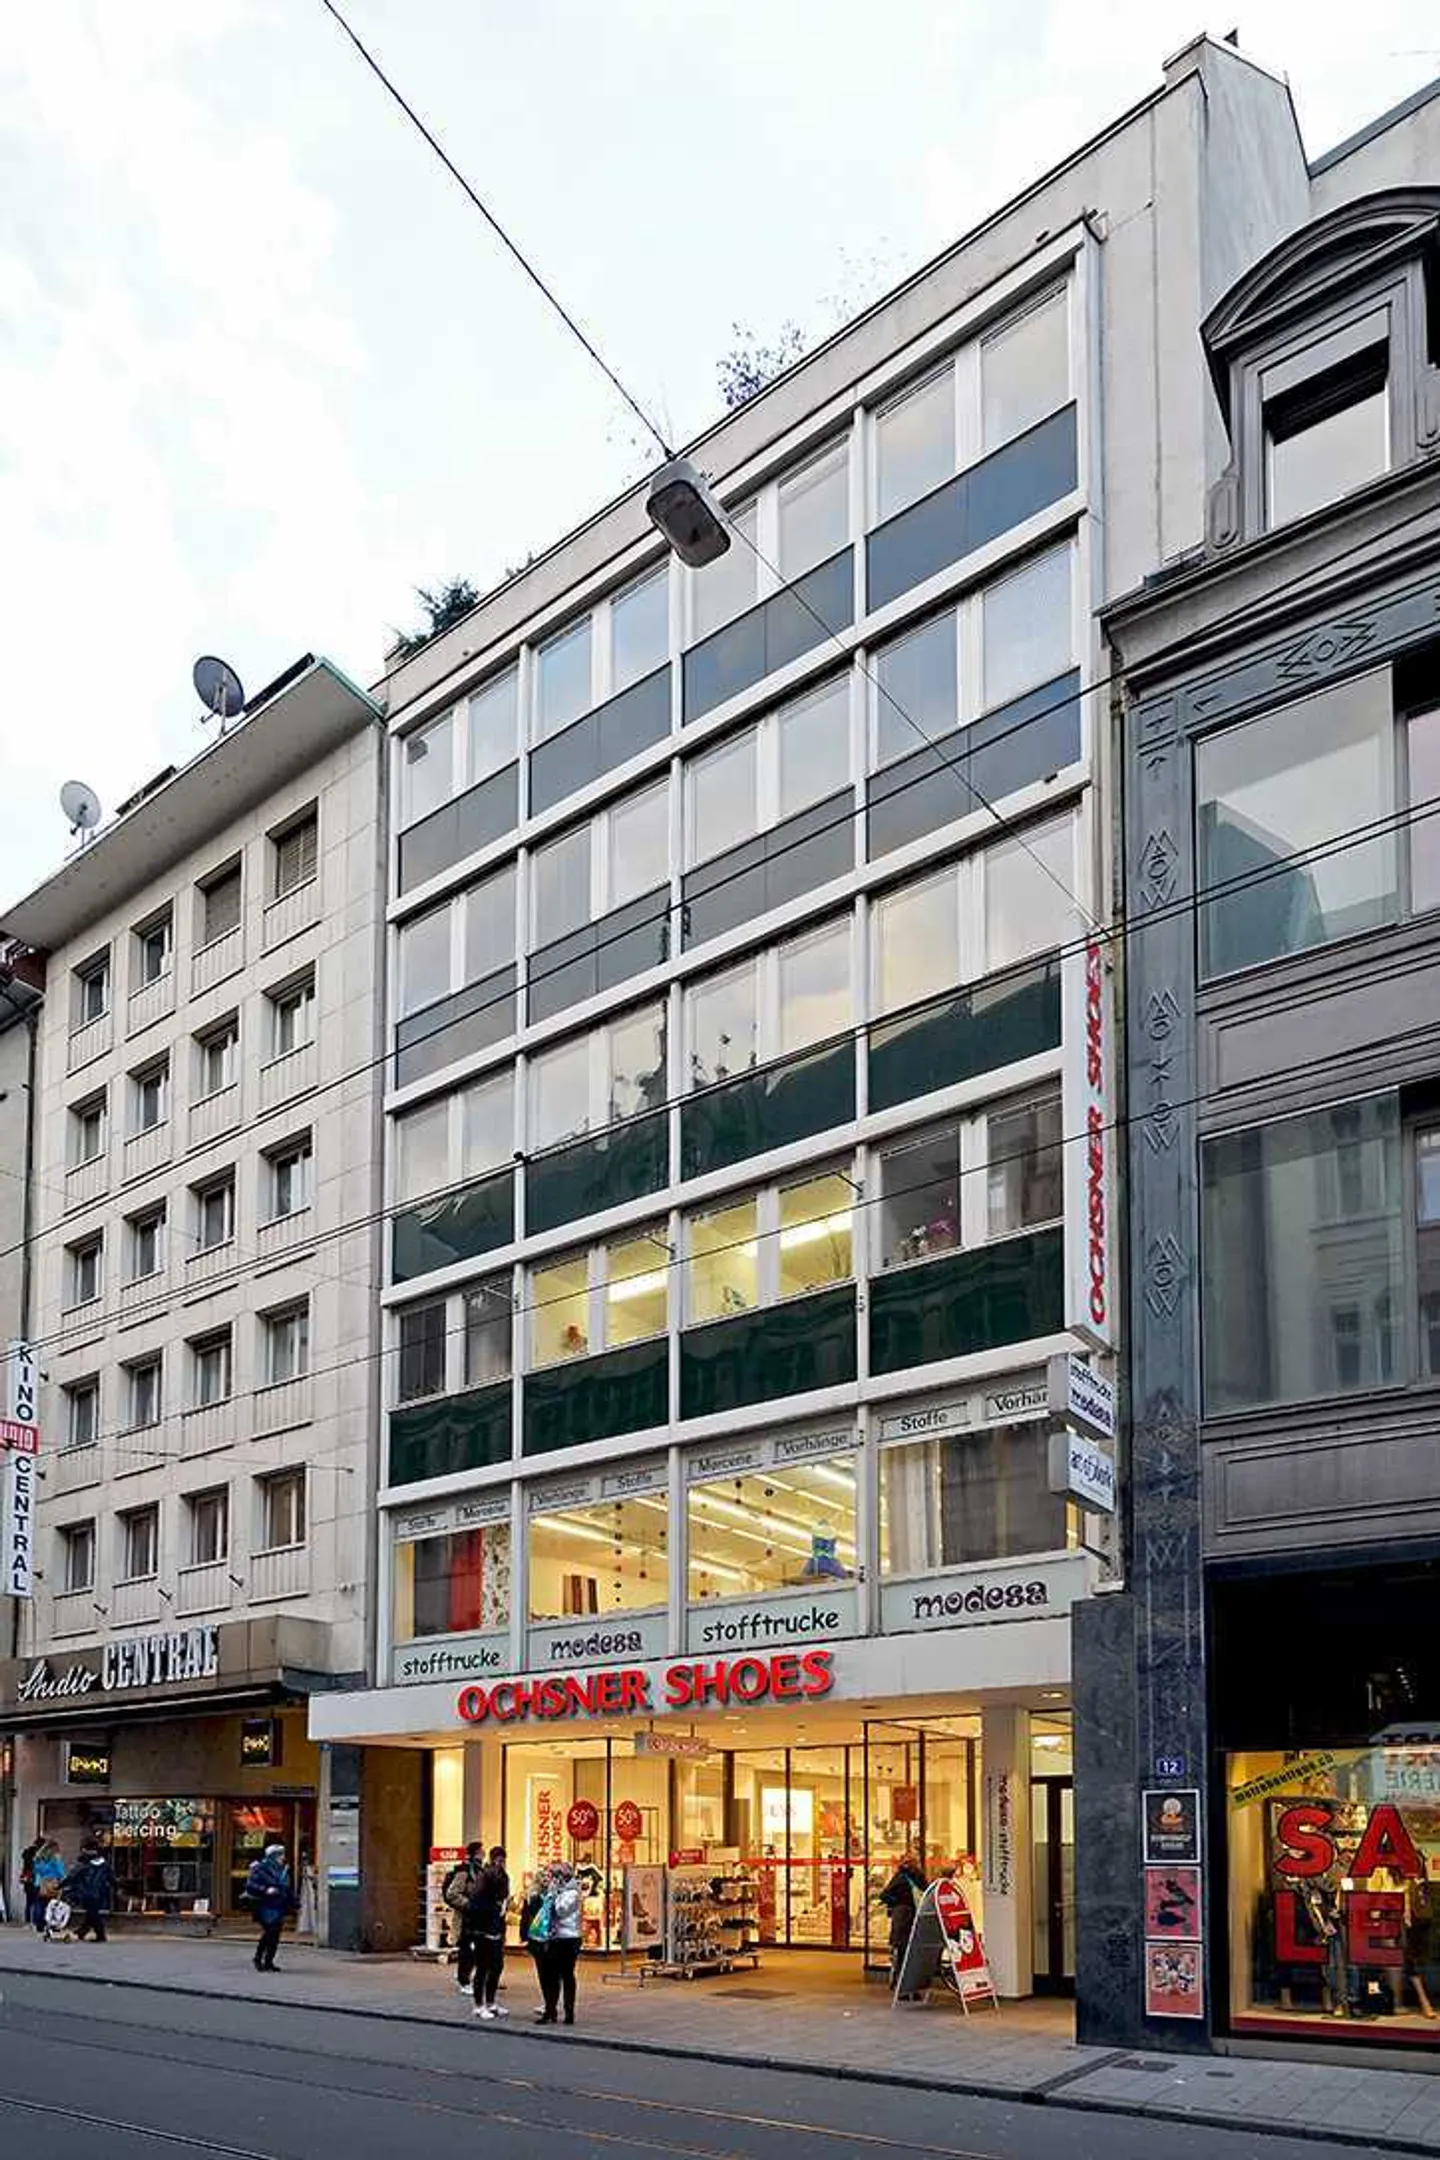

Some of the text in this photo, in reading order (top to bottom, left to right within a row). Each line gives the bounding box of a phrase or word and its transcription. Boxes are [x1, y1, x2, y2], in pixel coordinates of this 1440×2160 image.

[1087, 936, 1105, 1324] OCHSNER SHOES
[16, 1345, 33, 1421] KINO
[901, 1409, 949, 1431] Stoffe
[12, 1456, 32, 1590] CENTRAL
[914, 1580, 1049, 1619] modesa
[702, 1608, 840, 1642] stofftrucke
[18, 1625, 217, 1701] Studio CENTRAL
[402, 1648, 501, 1676] stofftrucke
[550, 1631, 642, 1660] modesa
[457, 1650, 831, 1723] OCHSNER SHOES
[113, 1823, 177, 1841] Piercing
